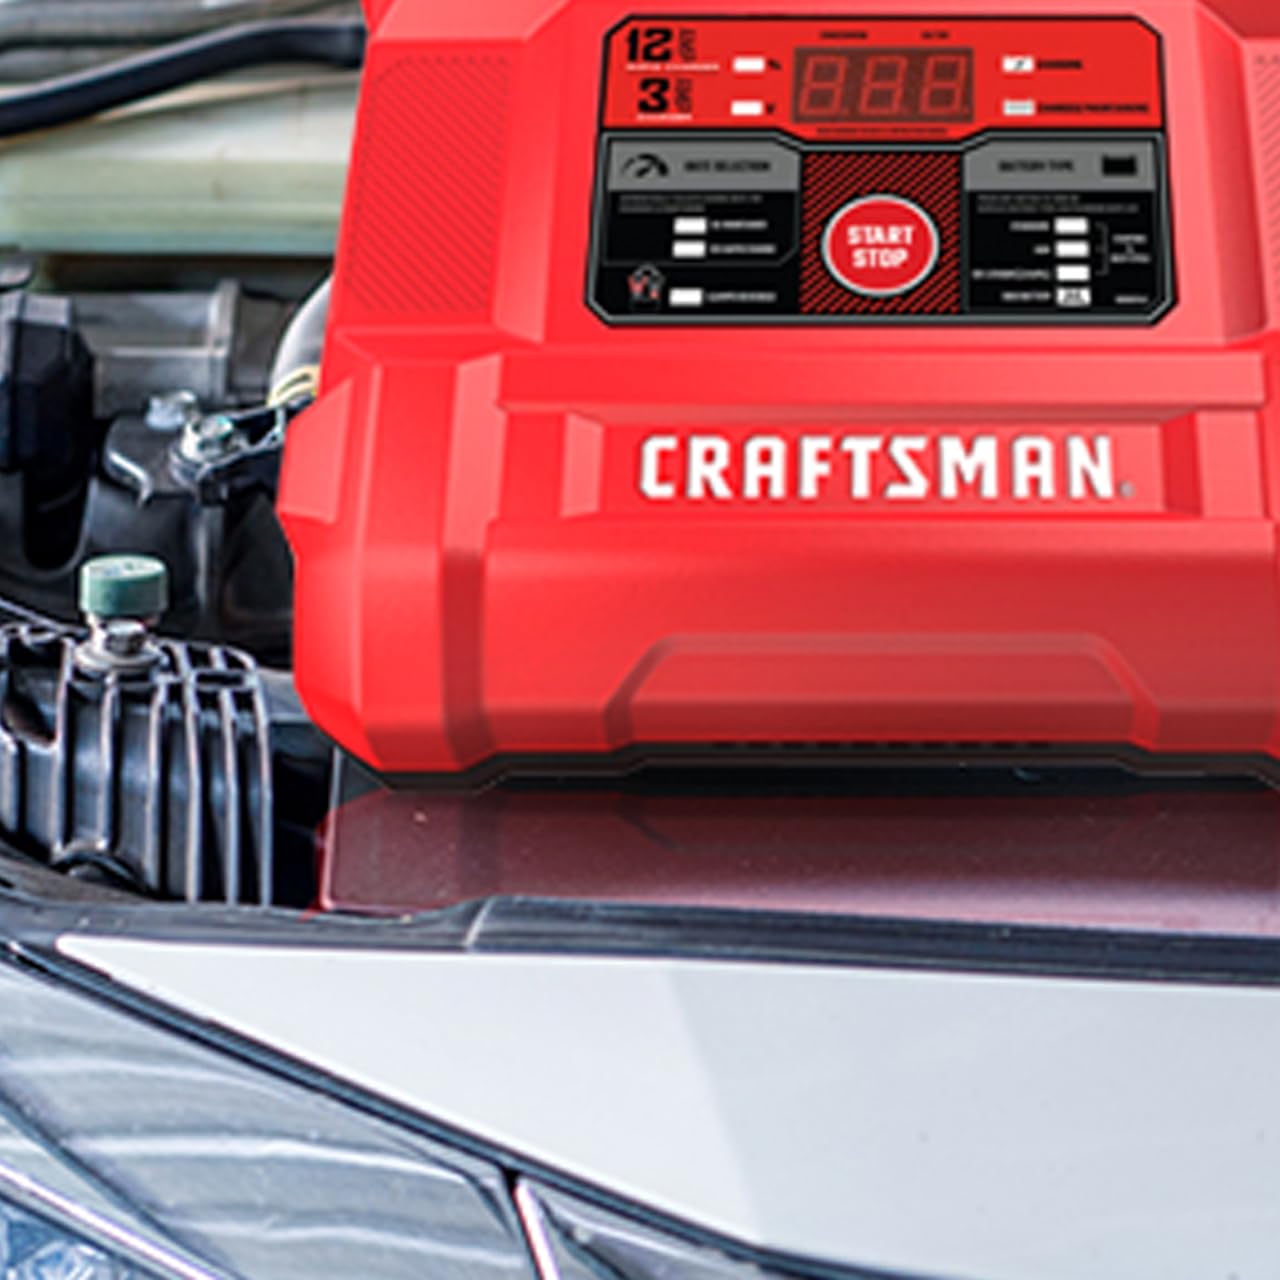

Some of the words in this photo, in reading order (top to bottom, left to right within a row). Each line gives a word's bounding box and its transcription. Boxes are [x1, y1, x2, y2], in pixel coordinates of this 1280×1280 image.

[627, 27, 673, 63] 12
[637, 77, 671, 113] 3
[847, 226, 914, 245] START
[853, 249, 908, 268] STOP
[640, 435, 1114, 499] CRAFTSMAN
